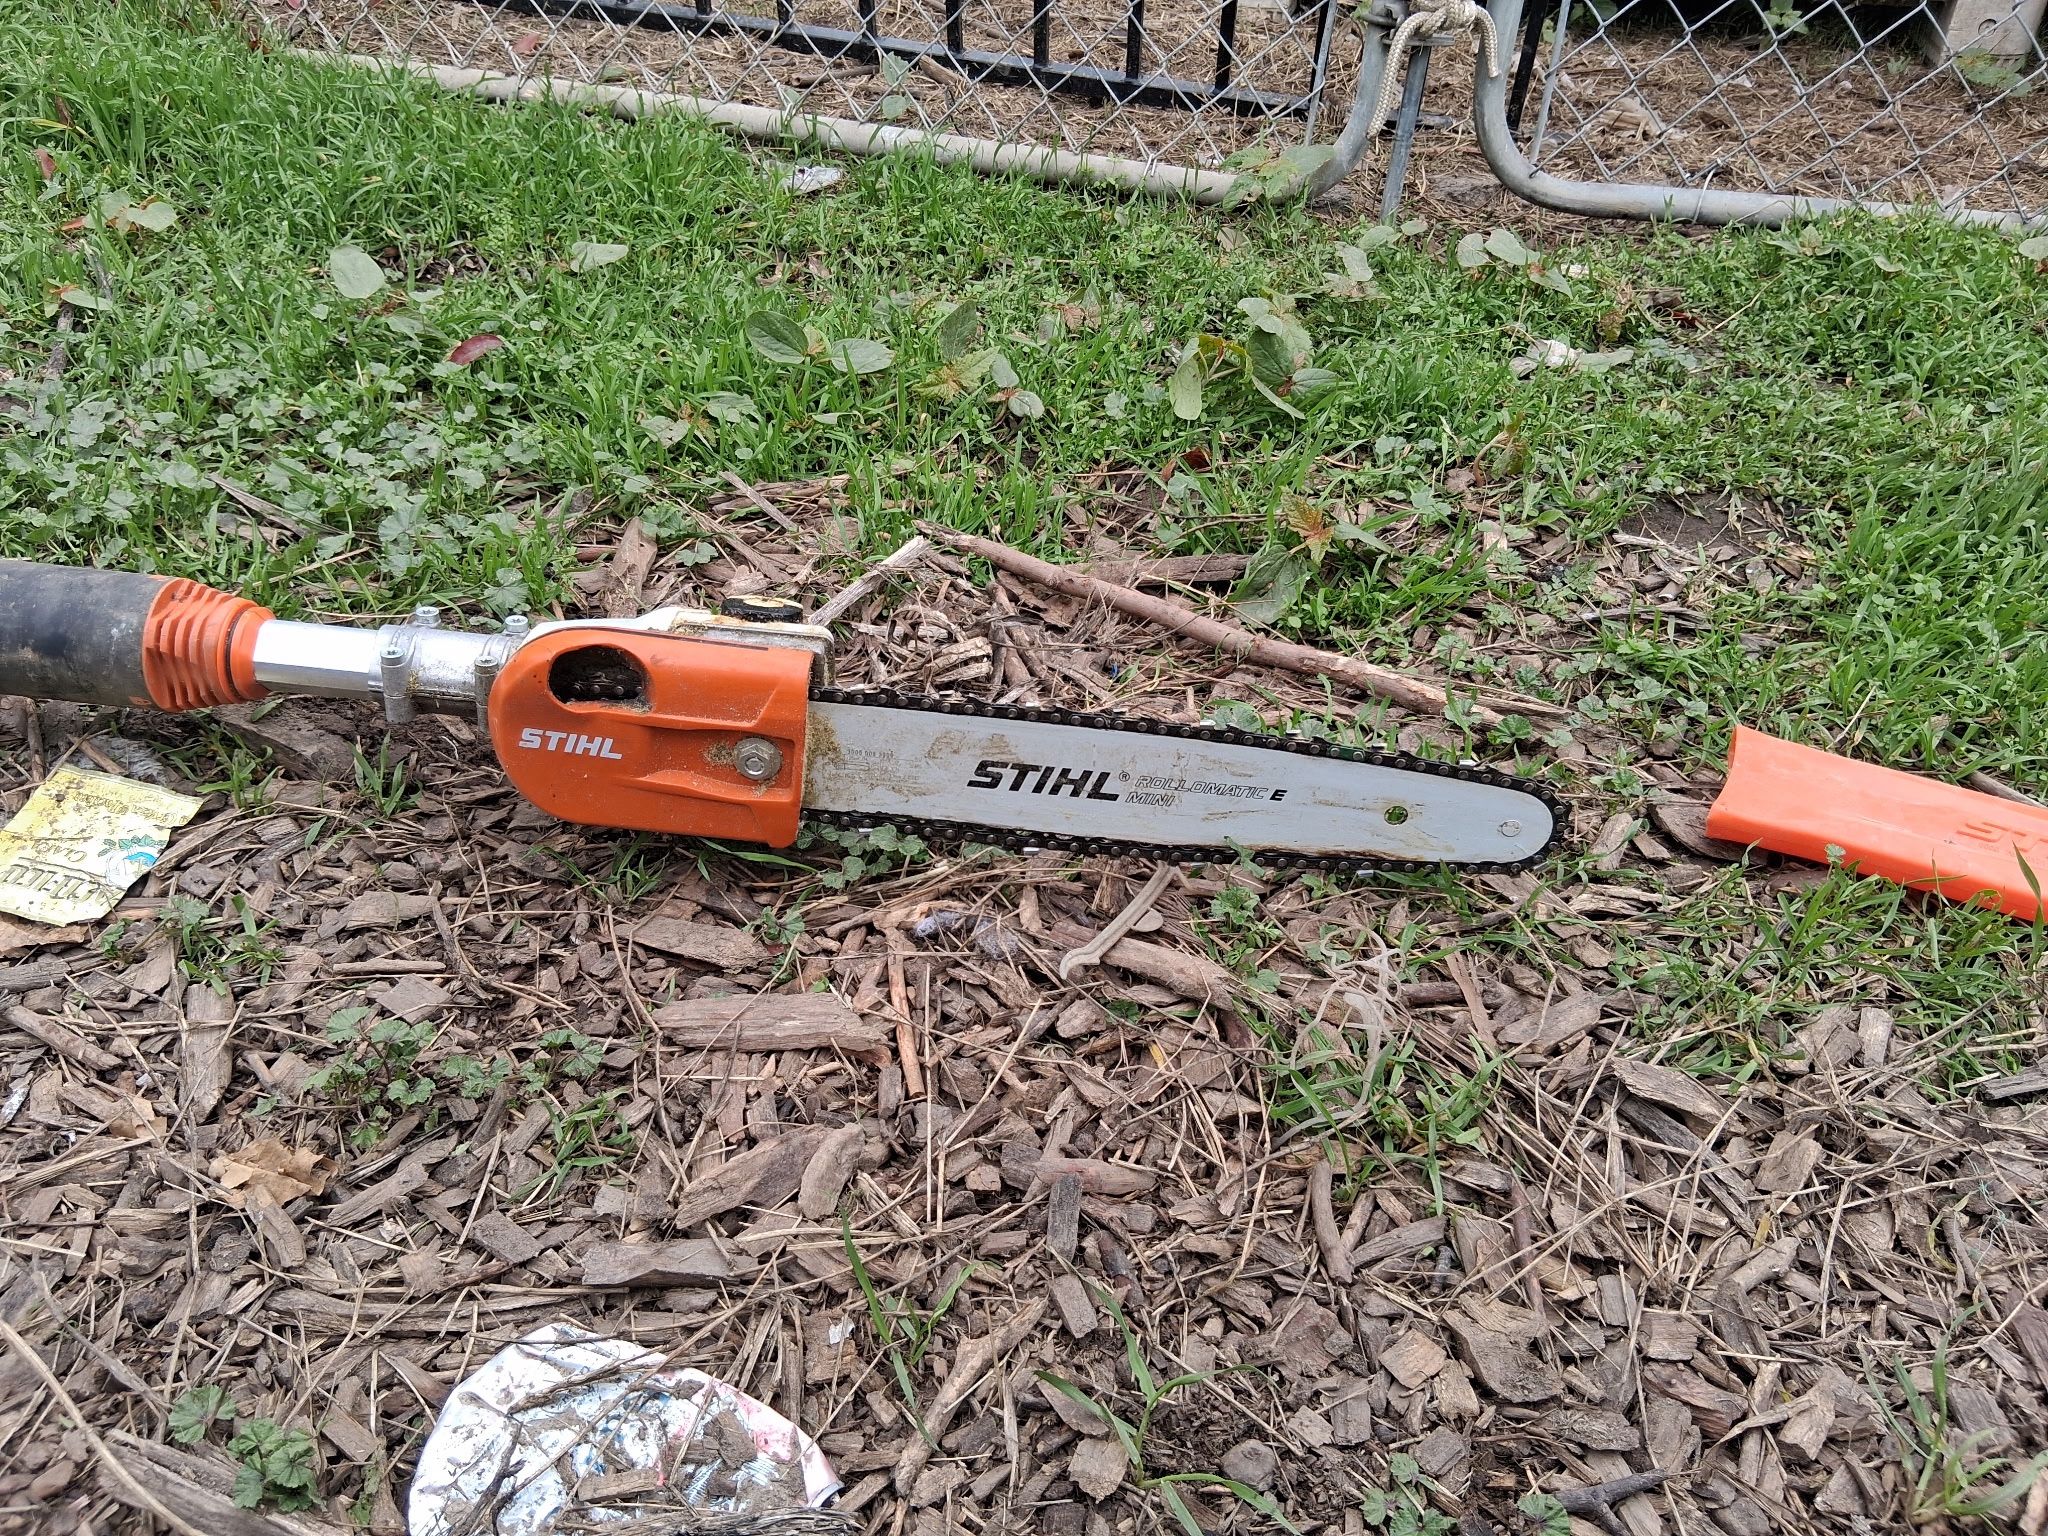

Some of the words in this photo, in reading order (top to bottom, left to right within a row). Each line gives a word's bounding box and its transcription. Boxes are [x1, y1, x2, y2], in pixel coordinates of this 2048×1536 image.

[518, 727, 623, 760] STIHL
[1125, 791, 1176, 807] MINI
[1134, 775, 1268, 800] ROLLOMATIC
[1269, 789, 1288, 802] E
